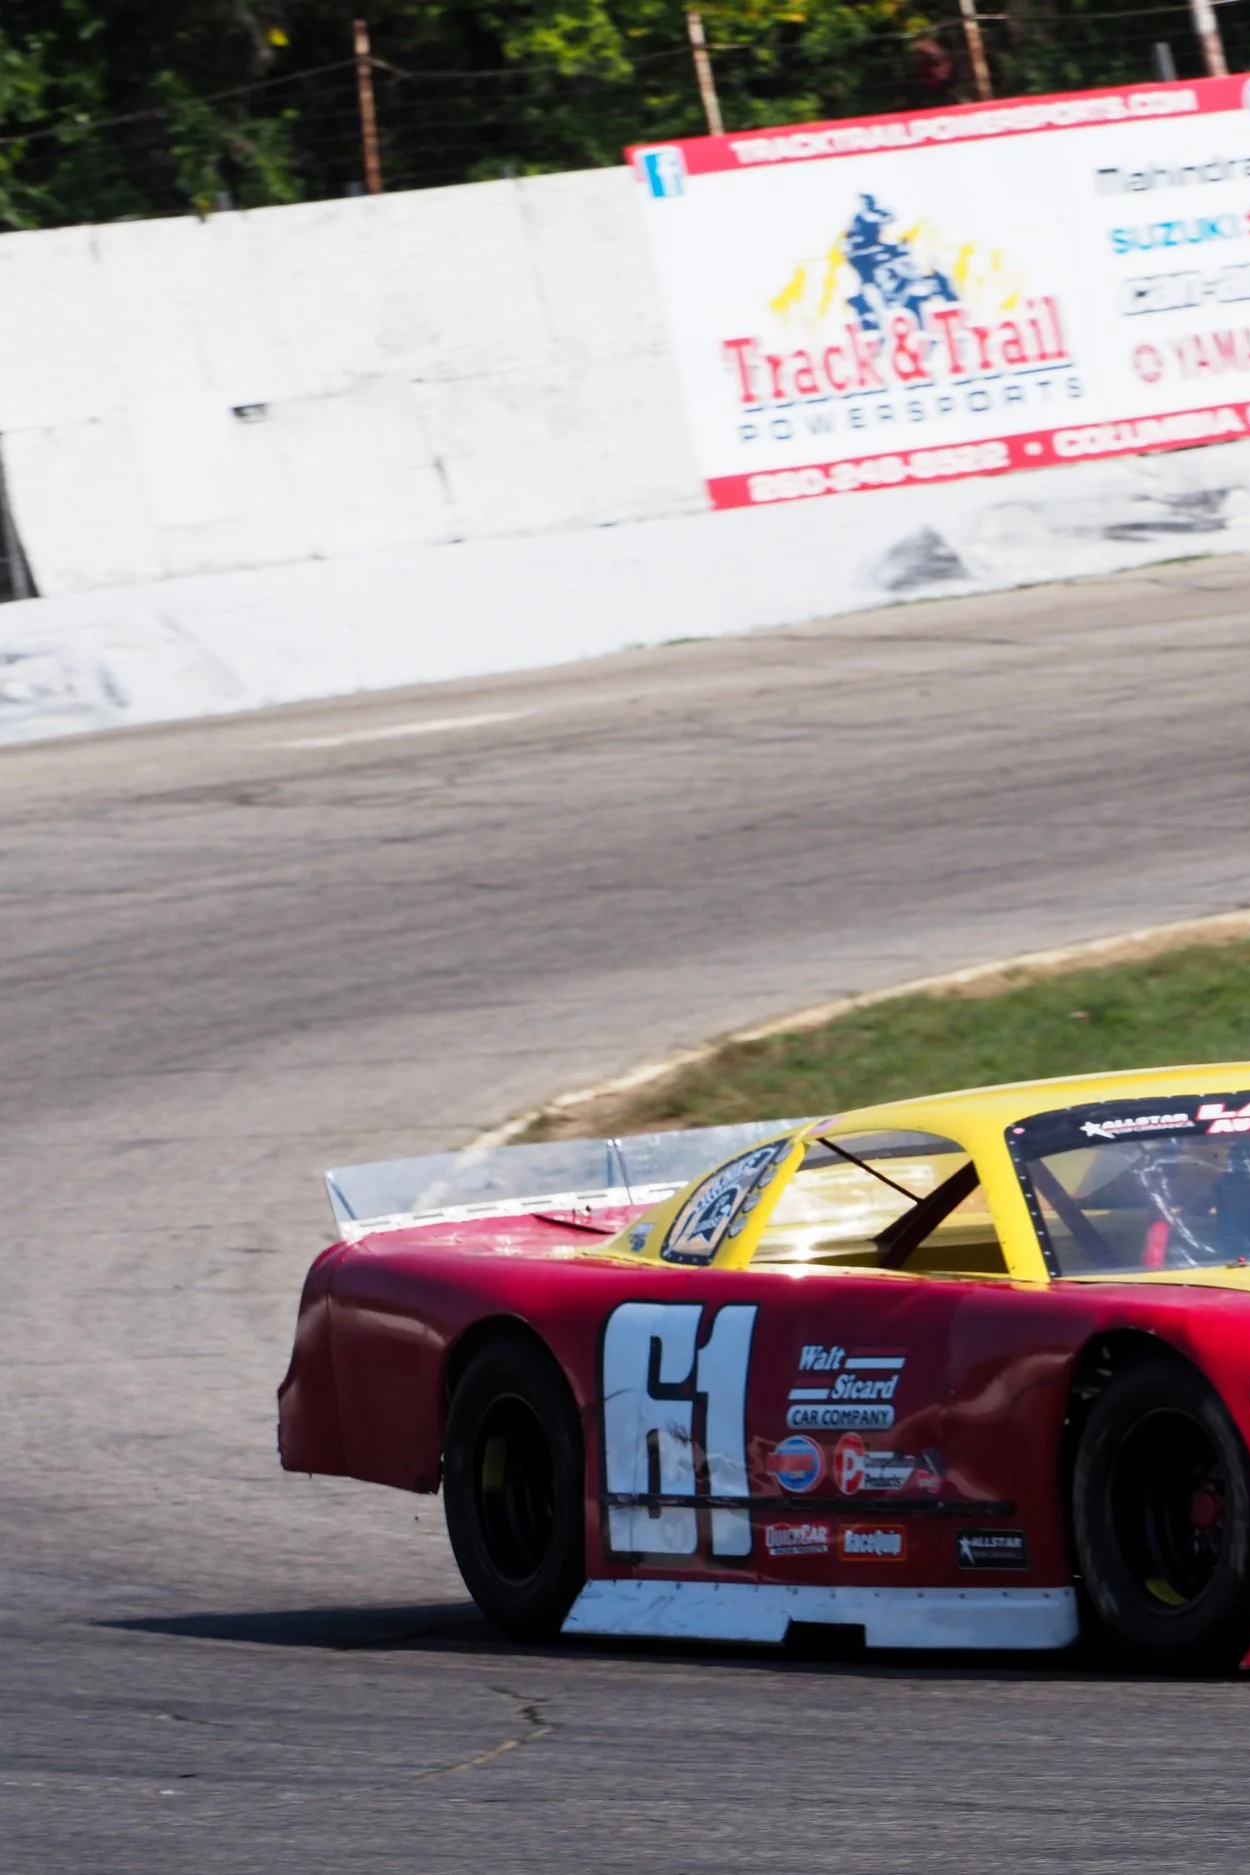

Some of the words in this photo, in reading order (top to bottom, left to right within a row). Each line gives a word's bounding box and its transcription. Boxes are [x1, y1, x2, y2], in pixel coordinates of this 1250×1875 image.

[1111, 213, 1242, 254] SUZUKI
[739, 376, 1083, 442] POWERSPORTS
[1102, 1112, 1189, 1131] ALLSTAR
[798, 1345, 846, 1370] Walt
[831, 1374, 898, 1399] Sicard
[602, 1302, 759, 1556] 61
[792, 1409, 819, 1425] CAR
[822, 1409, 889, 1425] COMPANY
[970, 1536, 1023, 1549] ALLSTAR
